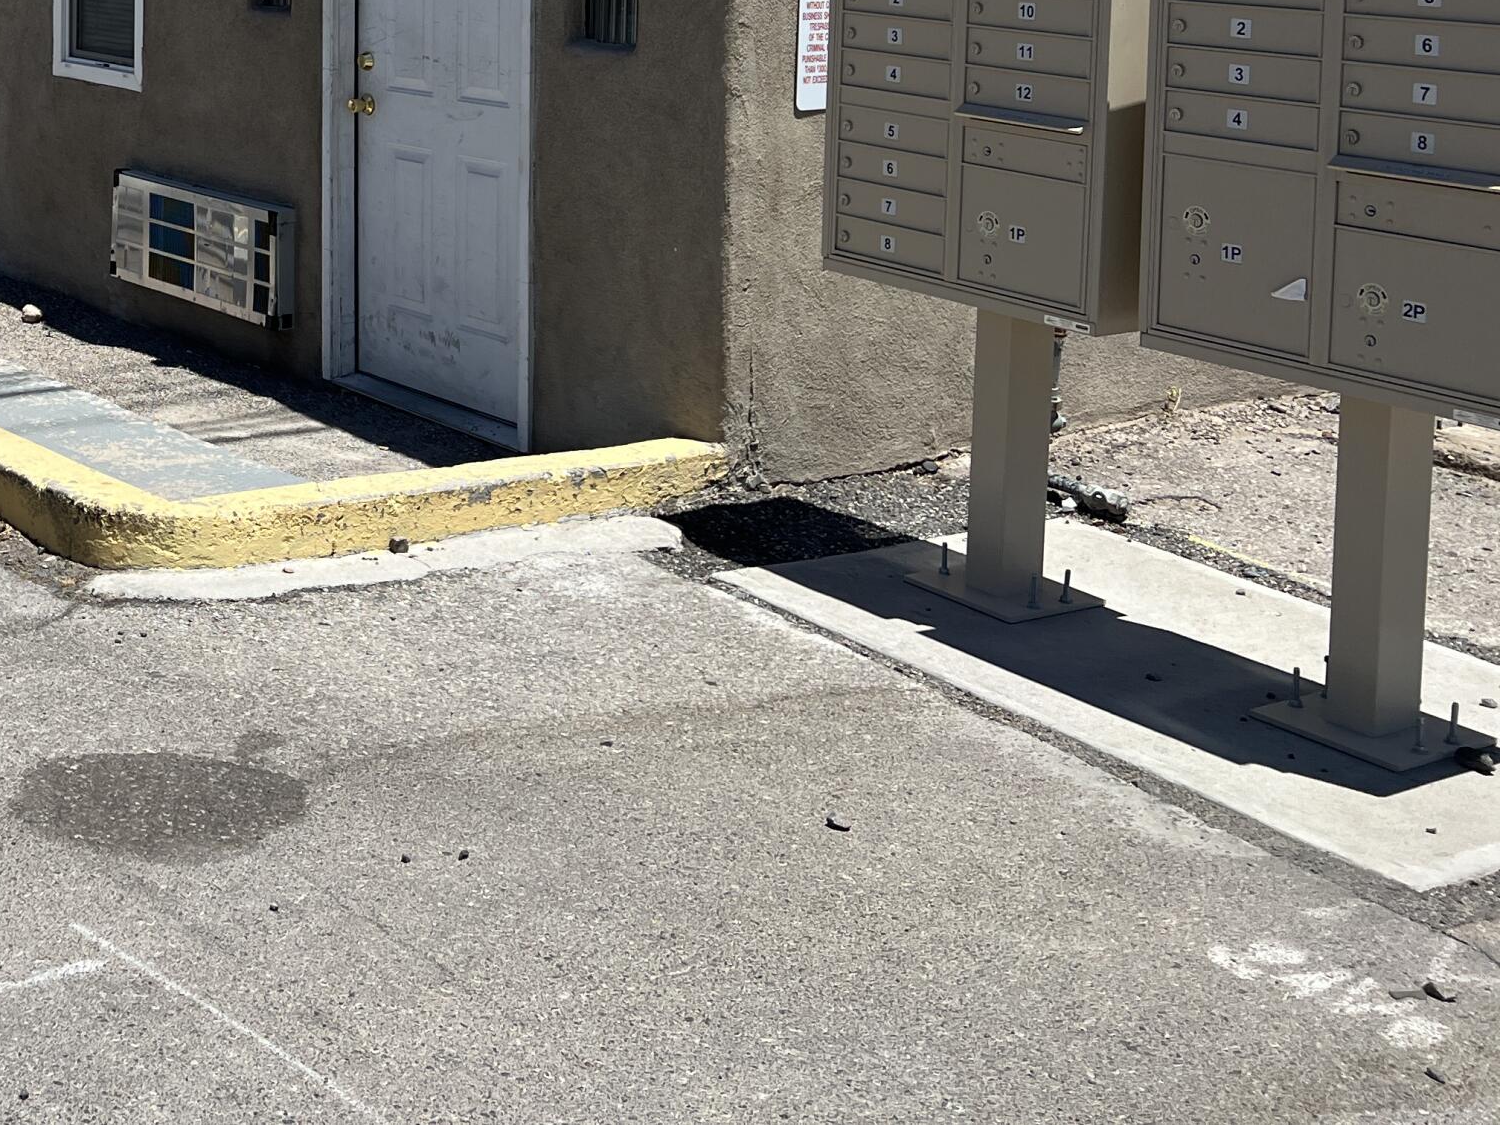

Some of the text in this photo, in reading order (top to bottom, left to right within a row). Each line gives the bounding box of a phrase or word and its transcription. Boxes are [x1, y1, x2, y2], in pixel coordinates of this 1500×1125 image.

[1019, 4, 1034, 18] 10
[1236, 21, 1246, 36] 2
[891, 30, 898, 42] 3
[1018, 45, 1032, 59] 11
[1422, 37, 1433, 53] 6
[889, 68, 897, 80] 4
[1234, 67, 1244, 82] 3
[1016, 86, 1031, 100] 12
[1419, 86, 1431, 101] 7
[1232, 112, 1242, 126] 4
[887, 125, 895, 137] 5
[1417, 135, 1428, 151] 8
[886, 162, 894, 175] 6
[885, 200, 892, 212] 7
[1009, 227, 1025, 240] 1P
[884, 237, 891, 250] 8
[1222, 245, 1242, 260] 1P
[1403, 302, 1426, 319] 2P
